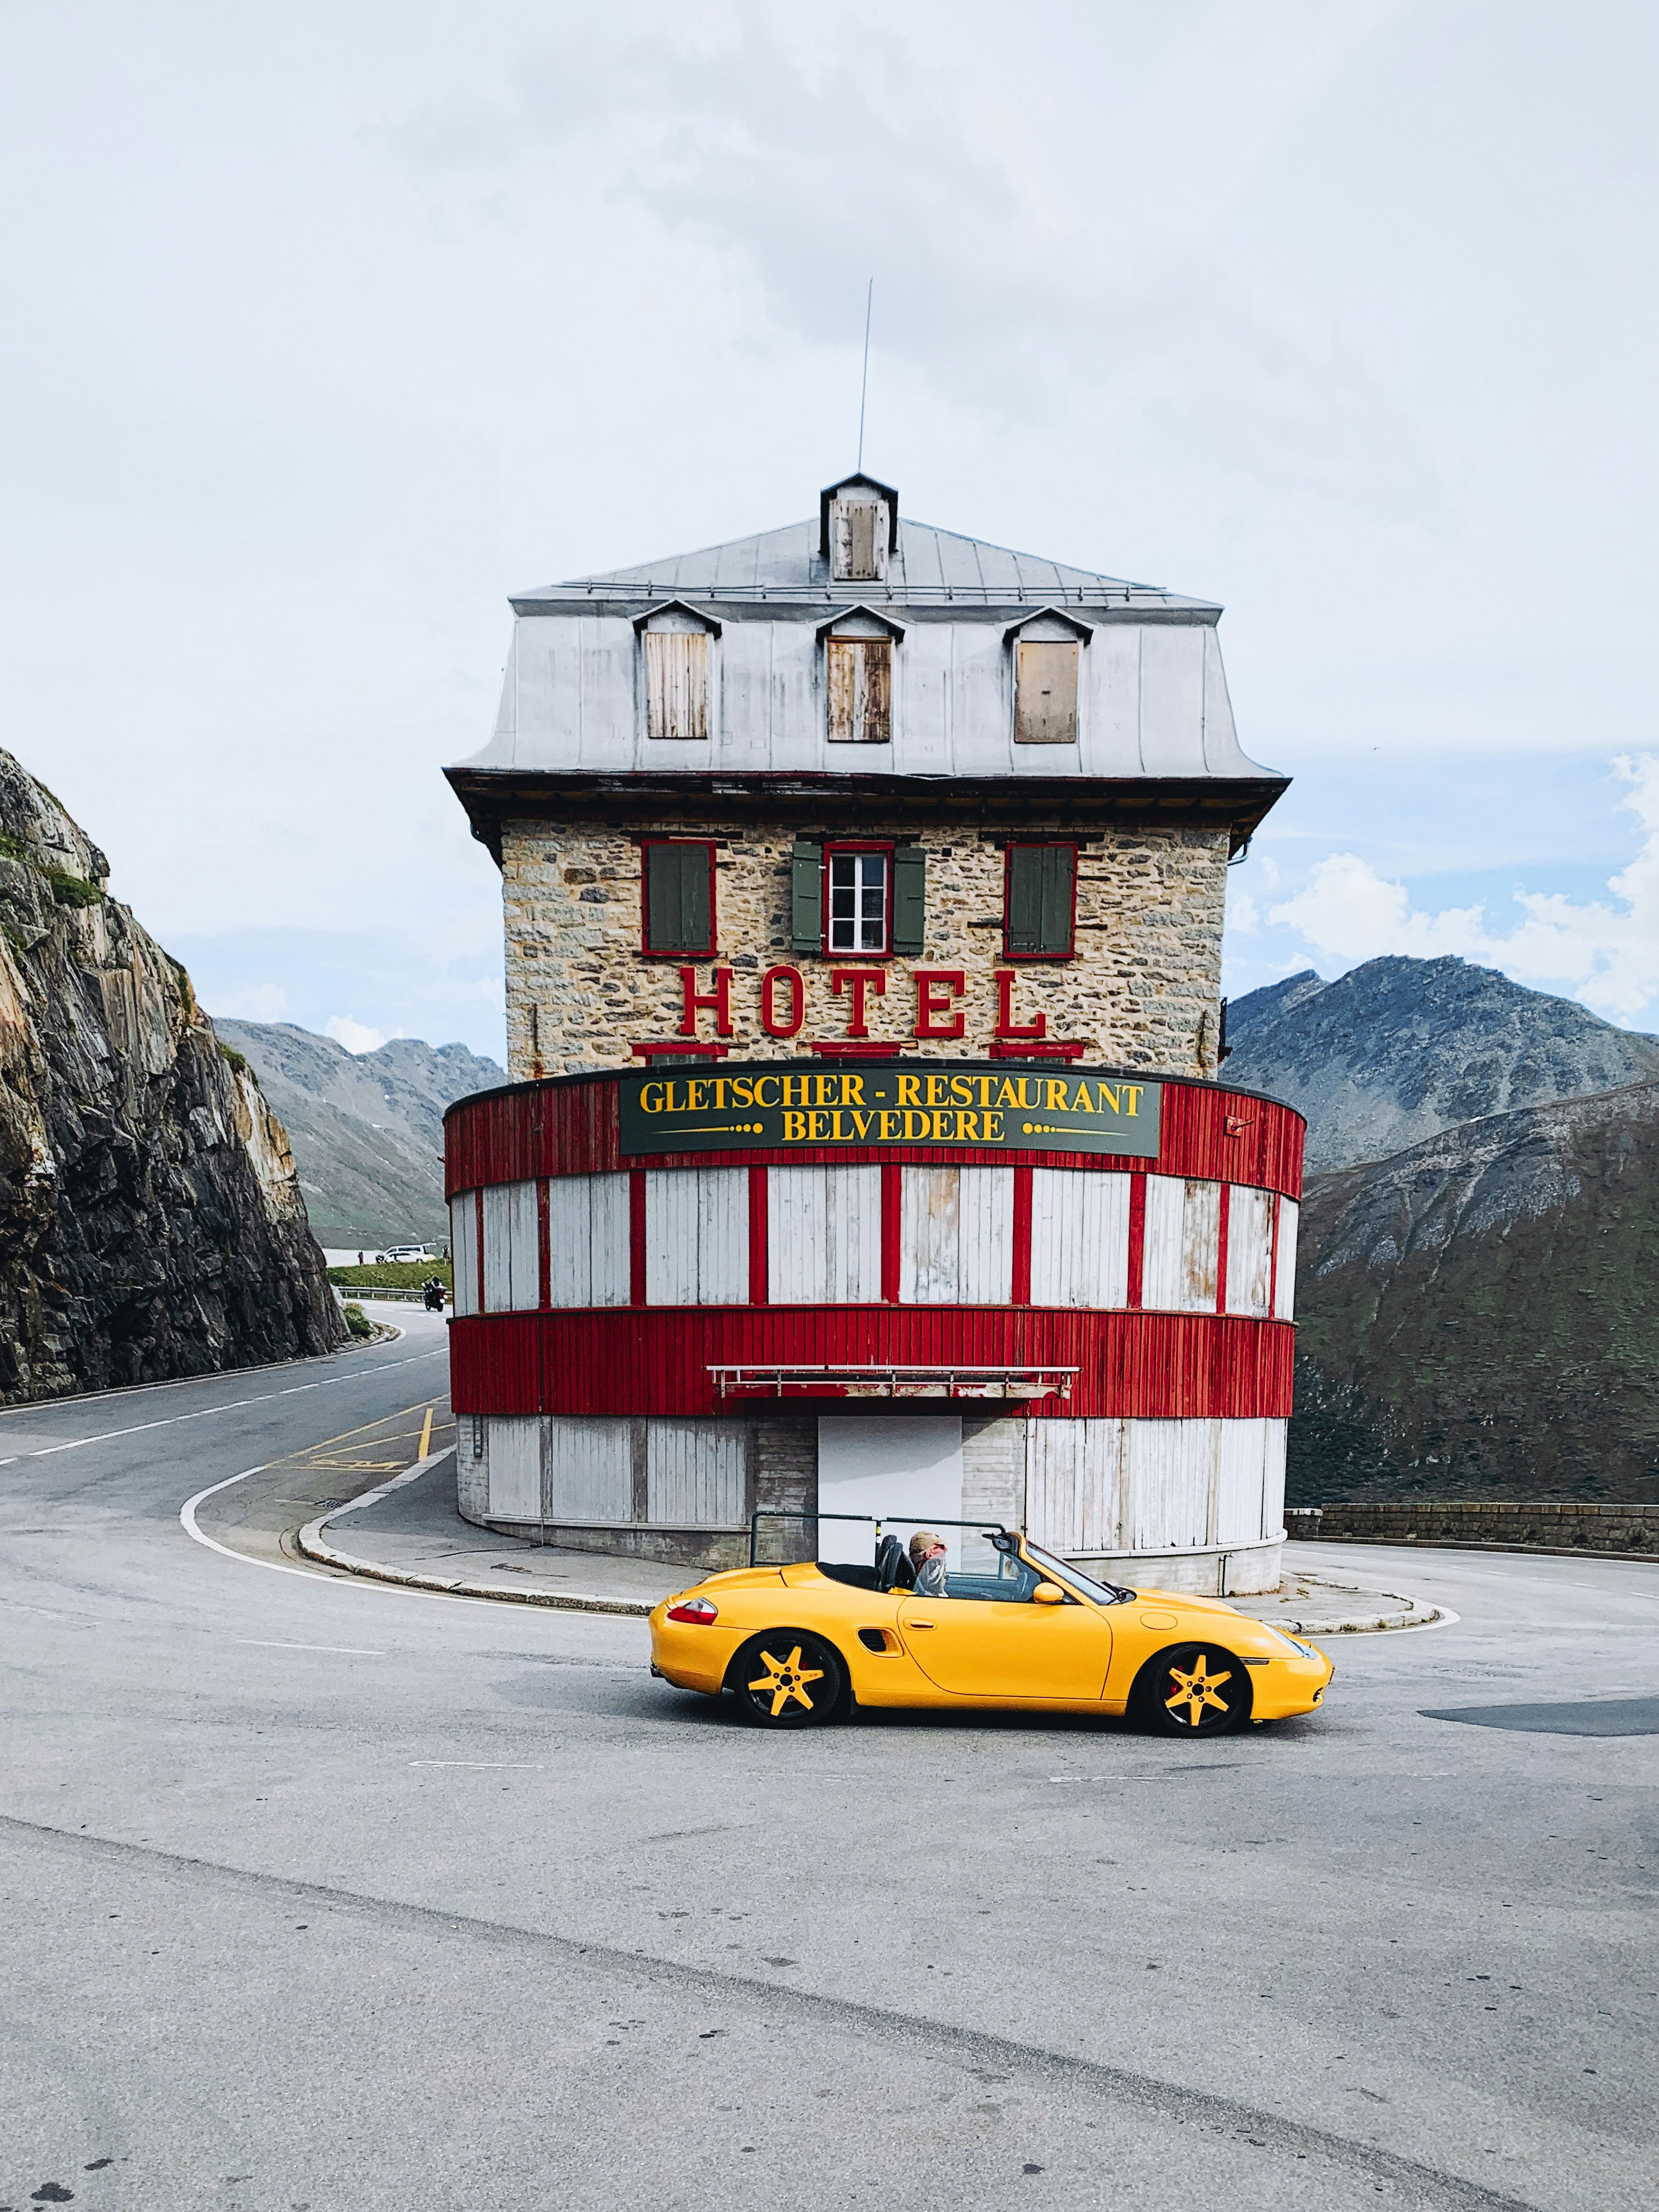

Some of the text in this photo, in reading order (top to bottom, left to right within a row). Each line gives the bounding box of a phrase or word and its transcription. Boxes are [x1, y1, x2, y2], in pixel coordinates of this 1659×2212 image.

[678, 965, 1046, 1037] HOTEL
[639, 1075, 865, 1113] GLETSCHER
[896, 1075, 1143, 1117] RESTAURANT
[783, 1110, 1005, 1142] BELVEDERE
